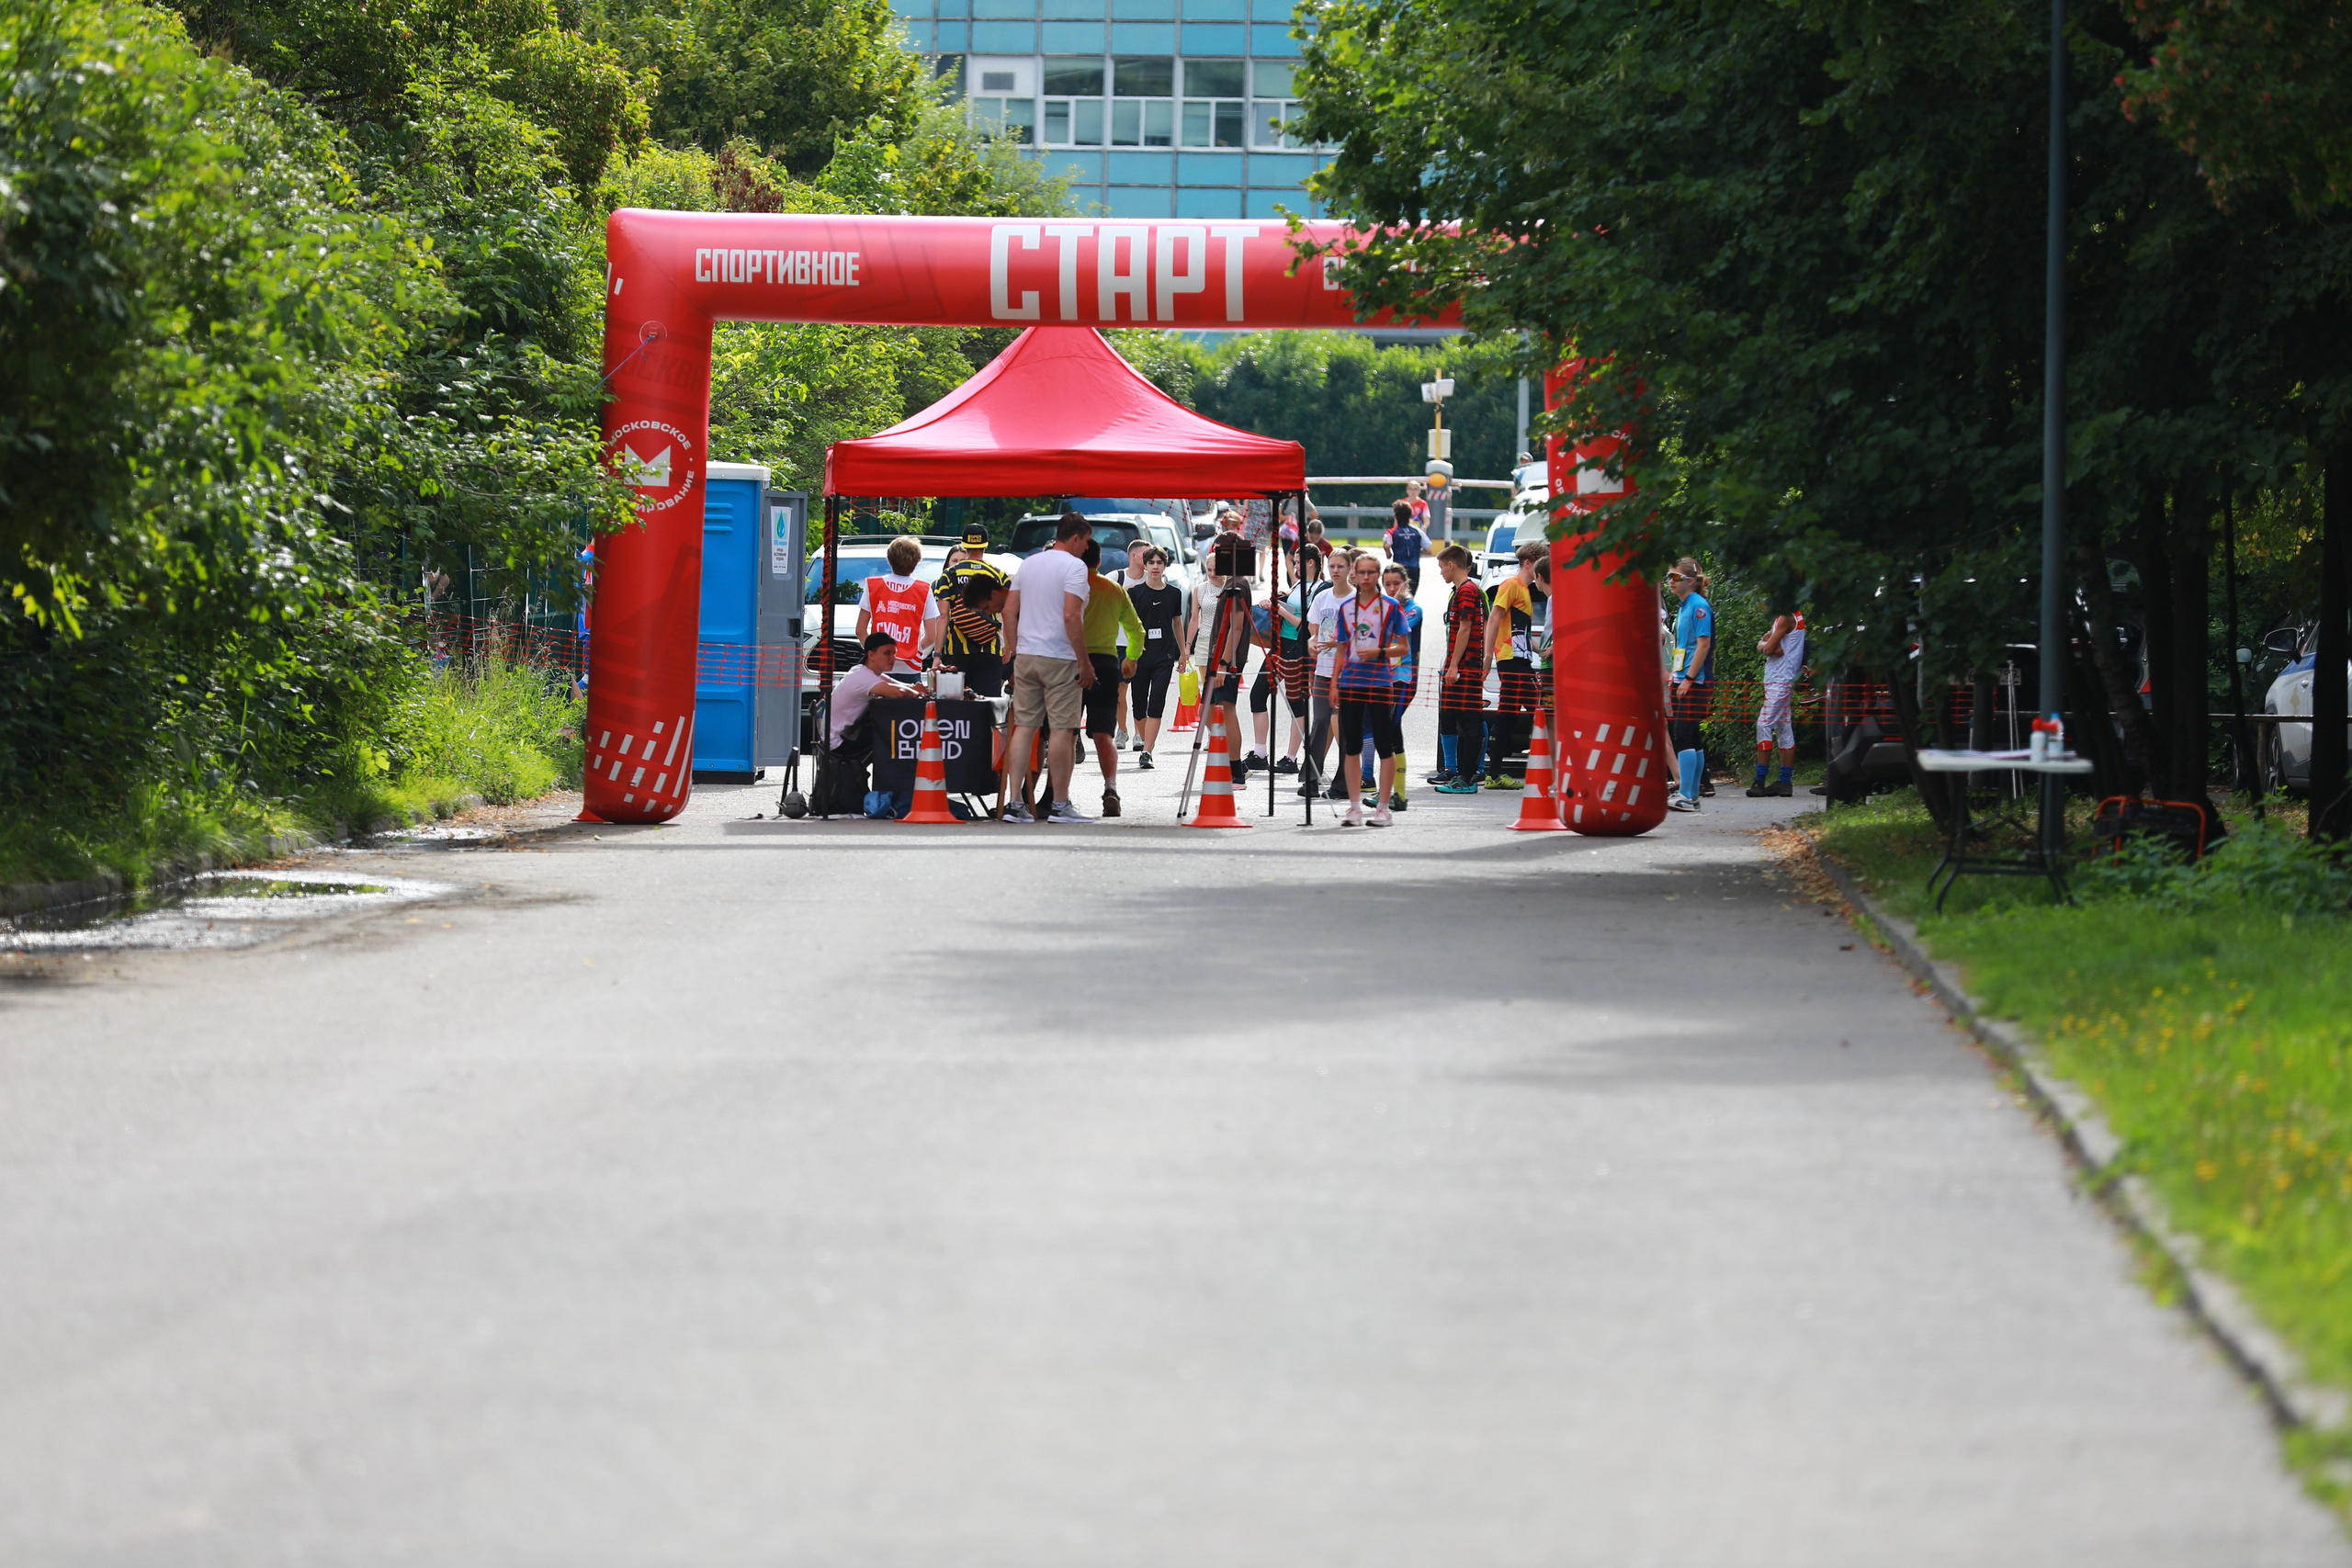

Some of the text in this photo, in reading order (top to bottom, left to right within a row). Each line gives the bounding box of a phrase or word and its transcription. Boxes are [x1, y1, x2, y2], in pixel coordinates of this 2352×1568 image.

[695, 248, 860, 286] СПОРТИВНОЕ
[990, 224, 1260, 321] СТАРТ
[898, 740, 963, 760] BD
